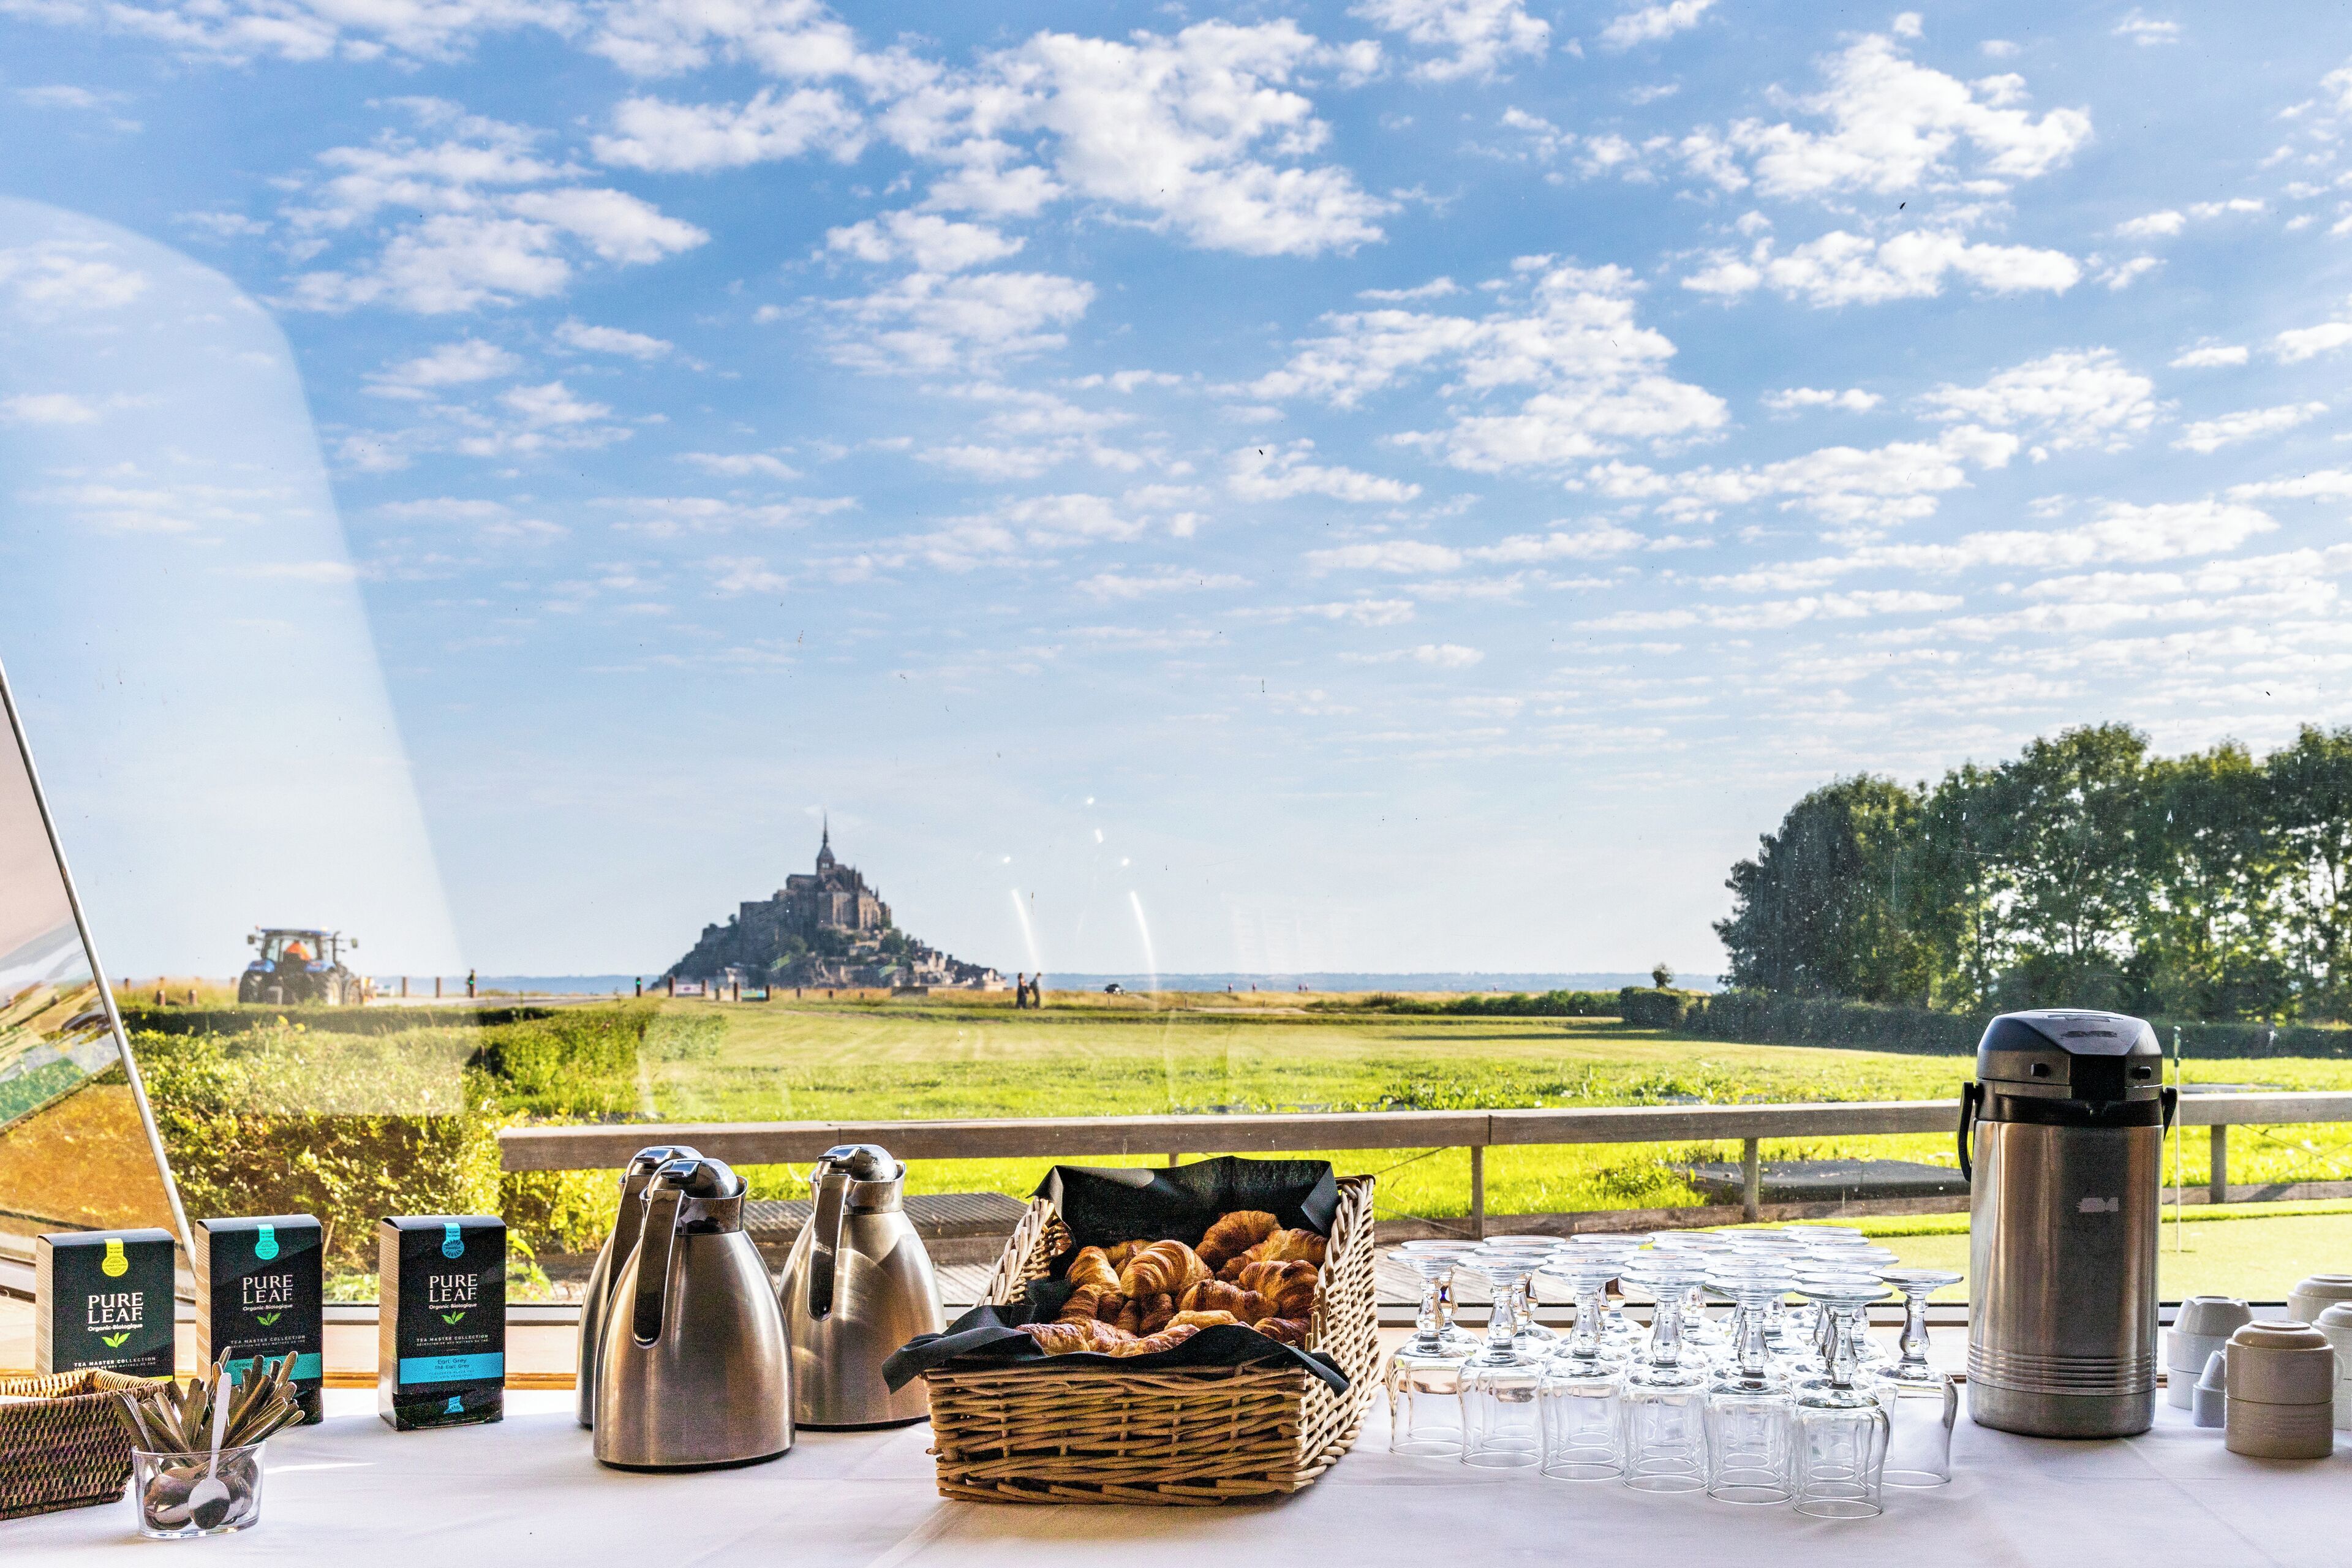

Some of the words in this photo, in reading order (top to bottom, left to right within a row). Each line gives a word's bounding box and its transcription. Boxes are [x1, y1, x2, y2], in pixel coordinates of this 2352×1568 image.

[243, 1274, 293, 1290] PURE
[429, 1274, 478, 1289] PURE
[88, 1292, 143, 1309] PURE
